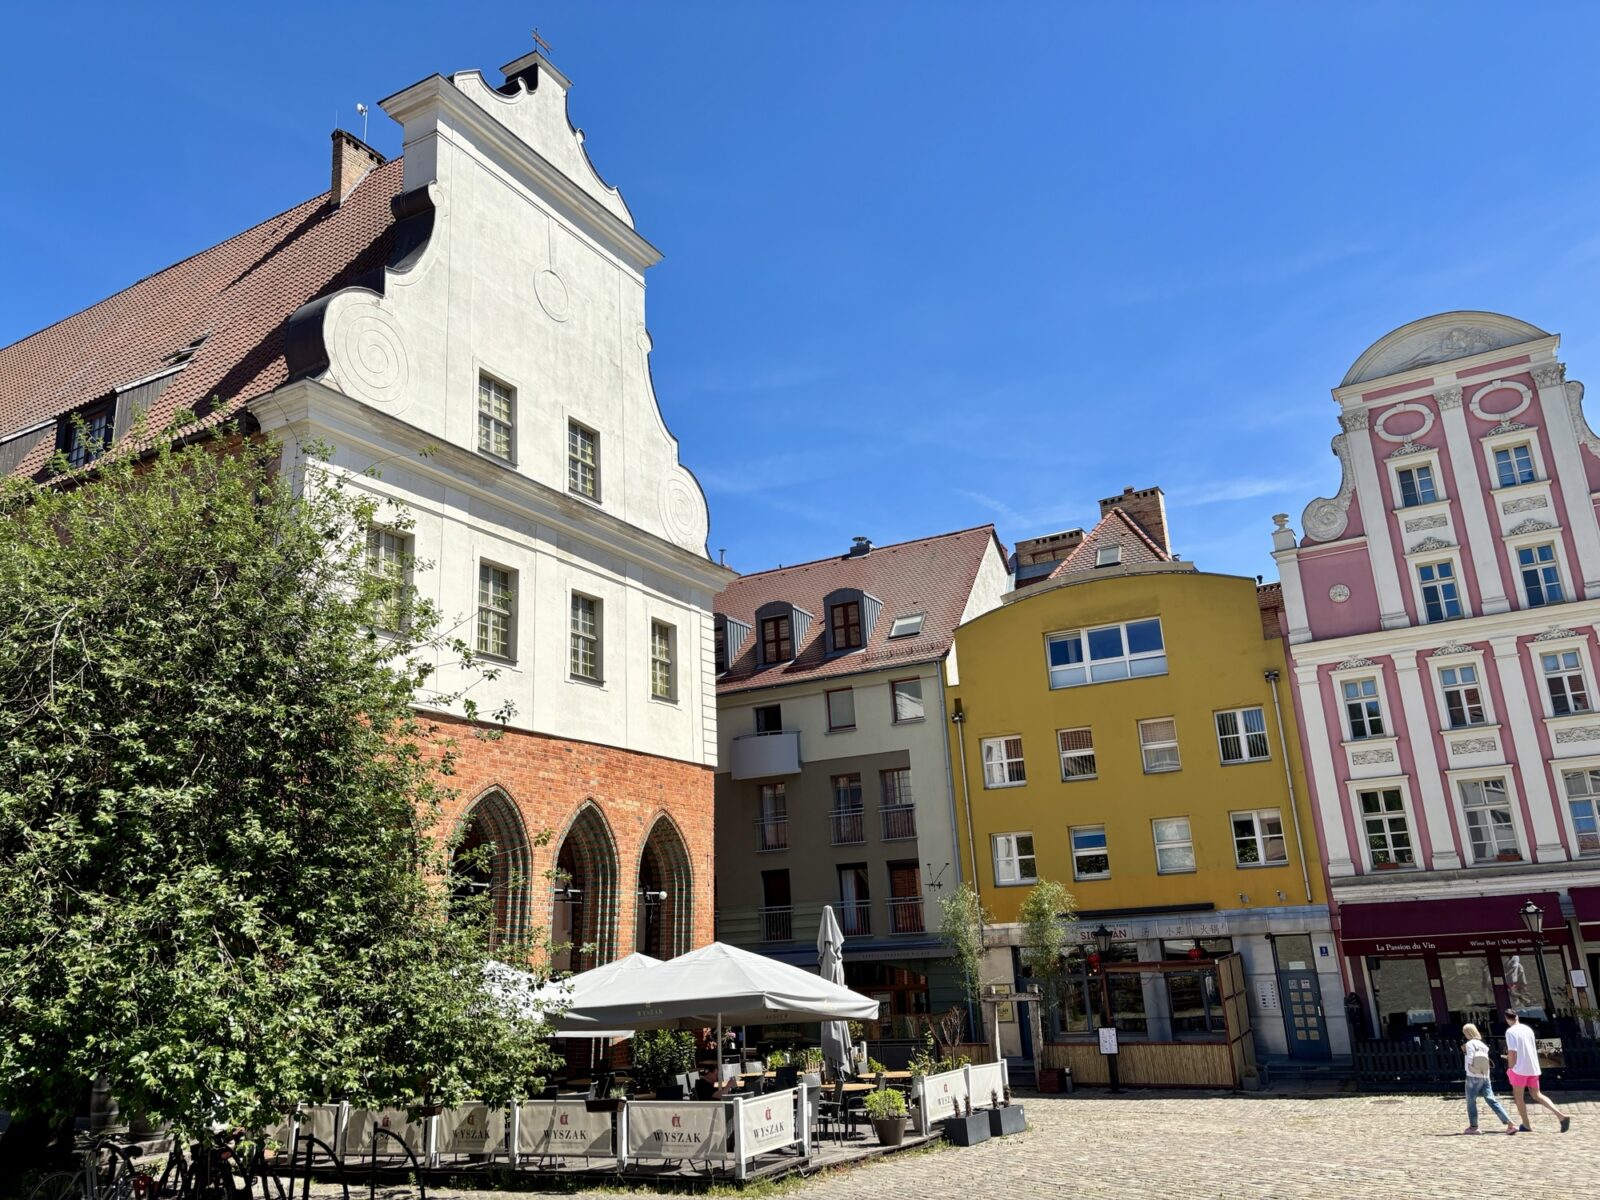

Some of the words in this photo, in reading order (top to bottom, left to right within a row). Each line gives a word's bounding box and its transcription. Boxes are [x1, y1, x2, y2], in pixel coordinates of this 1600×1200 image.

[1385, 943, 1411, 951] Passion
[1412, 942, 1421, 950] du
[452, 1129, 490, 1139] WYSZAK
[543, 1129, 587, 1140] WYSZAK
[753, 1121, 785, 1139] WYSZAK
[654, 1132, 701, 1143] WYSZAK
